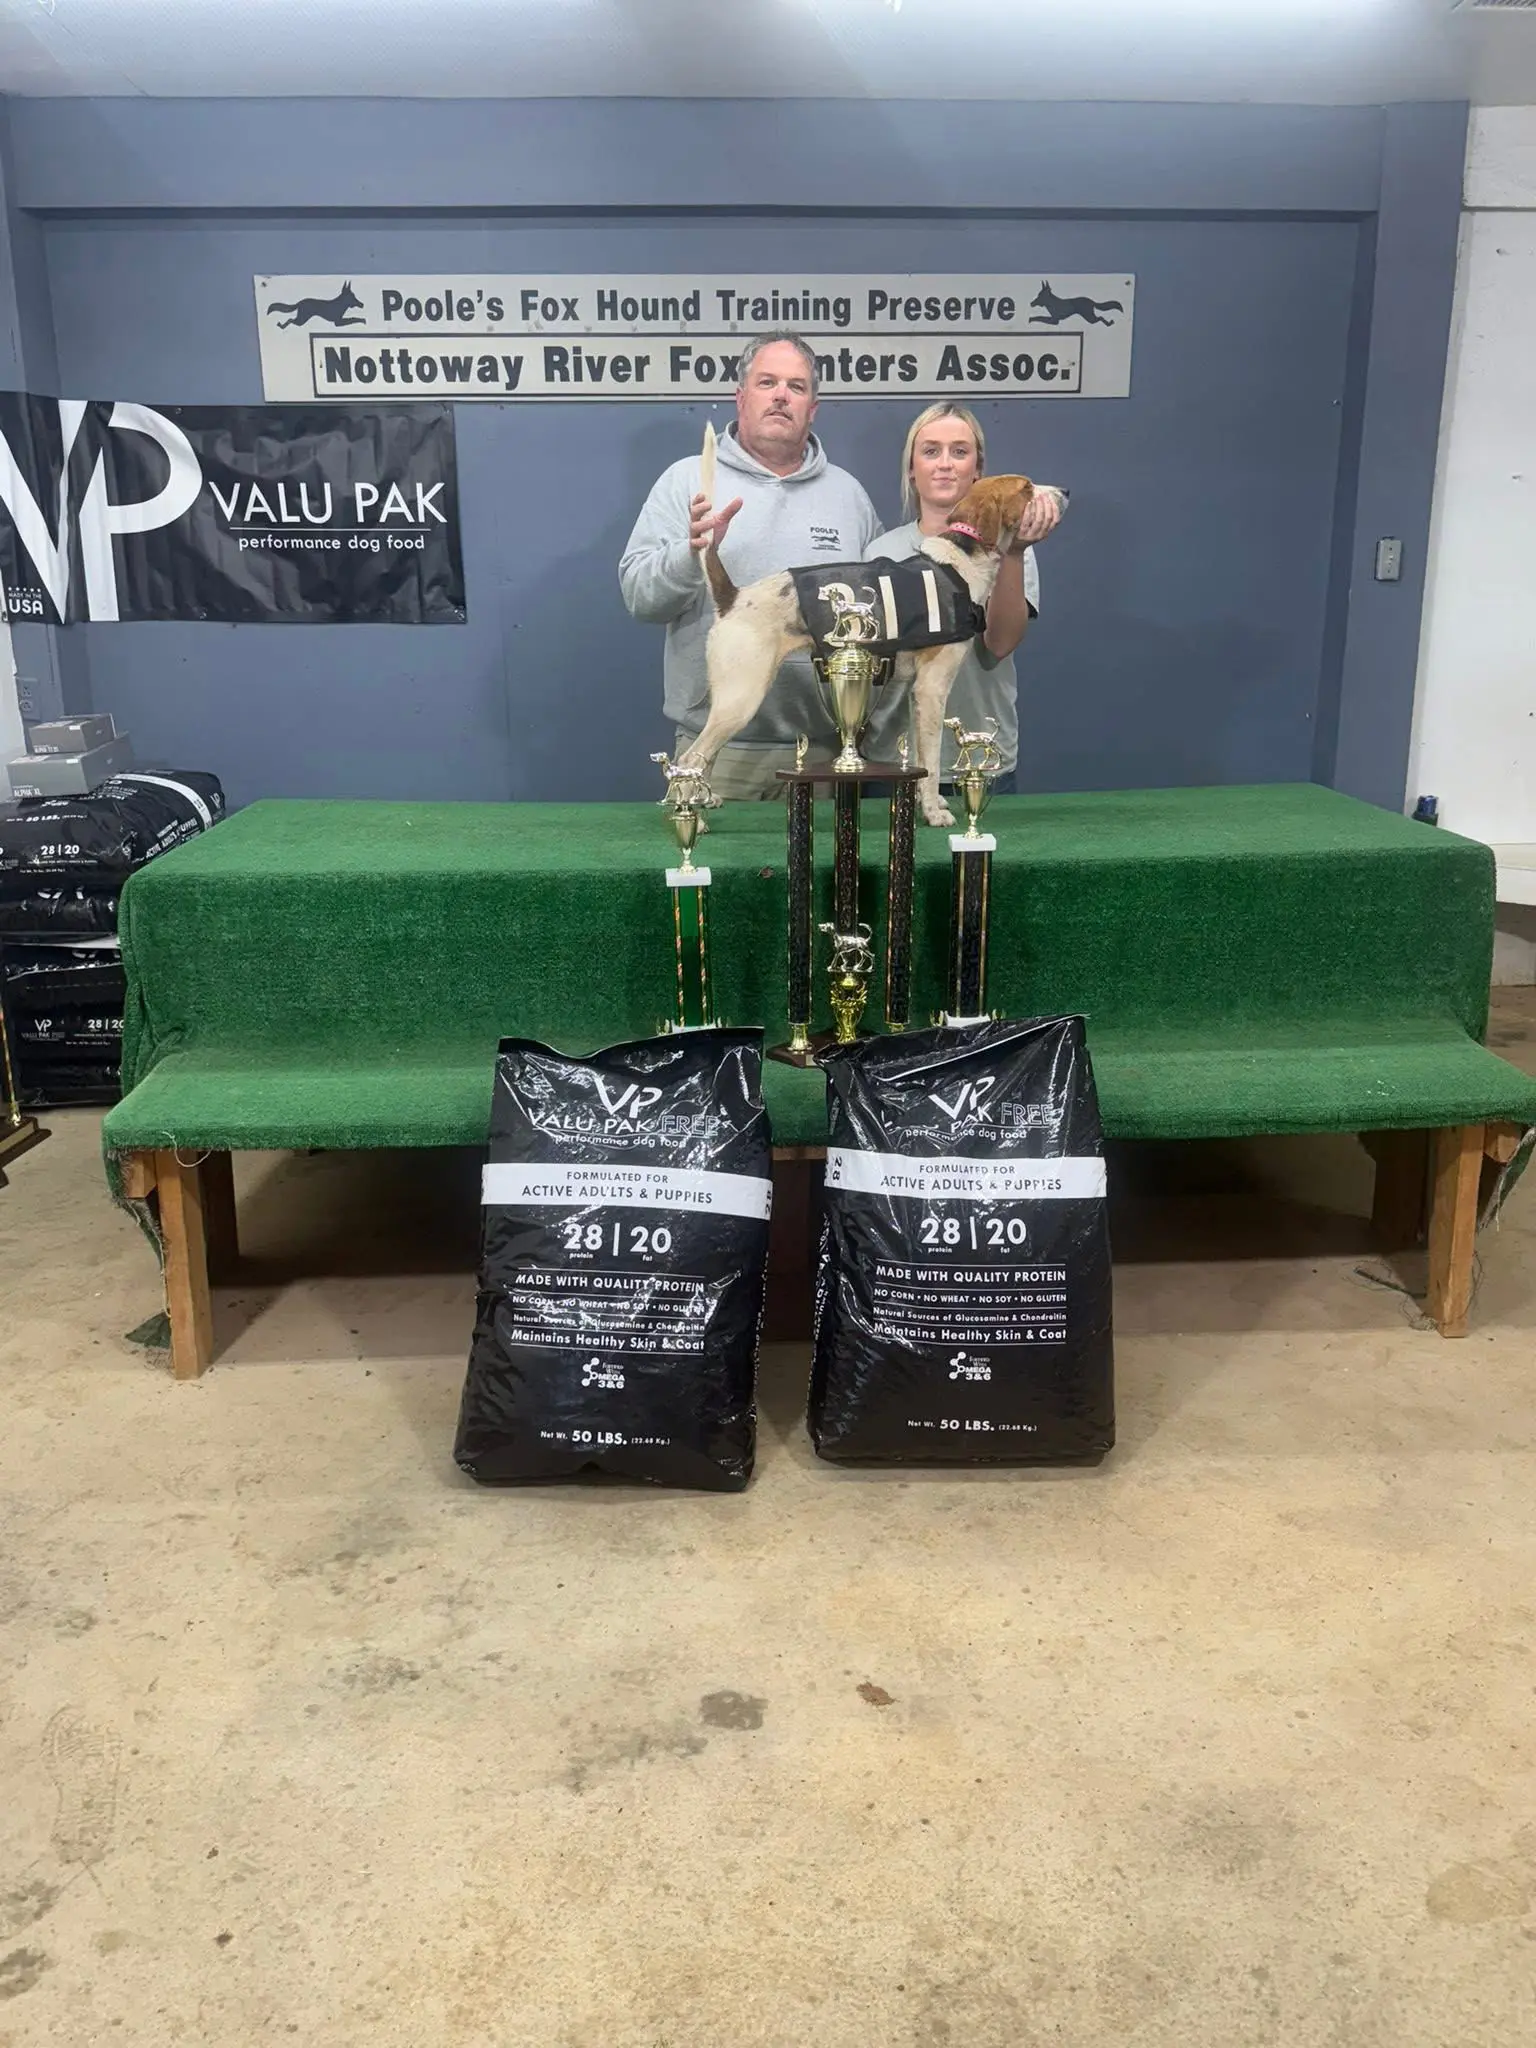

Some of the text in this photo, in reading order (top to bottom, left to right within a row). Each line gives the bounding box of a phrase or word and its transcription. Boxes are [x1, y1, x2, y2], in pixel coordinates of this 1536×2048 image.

[382, 289, 1016, 327] Poole's Fox Hound Training Preserve
[324, 344, 1071, 391] Nottoway River Fox nters Assoc.
[208, 480, 448, 525] VALU PAK
[238, 534, 426, 553] performance dog food
[9, 599, 44, 615] USA
[40, 844, 80, 855] 28 20
[34, 1019, 52, 1032] VP
[88, 1019, 102, 1028] 28
[594, 1077, 663, 1119] VP
[928, 1075, 996, 1121] VP
[527, 1107, 719, 1137] VALU PAK FREE
[1001, 1102, 1053, 1126] FREE
[633, 1135, 656, 1148] dog
[978, 1127, 997, 1141] dog
[1000, 1127, 1027, 1140] food
[566, 1171, 669, 1183] FORMULATED FOR
[919, 1164, 1016, 1174] FORMULATED FOR
[880, 1175, 925, 1190] ACTIVE
[931, 1178, 983, 1191] ADULTS
[1004, 1178, 1062, 1191] PUPPIES
[522, 1185, 713, 1204] ACTIVE ADULTS & PUPPIES
[563, 1223, 672, 1254] 28 20
[920, 1217, 1027, 1245] 28 20
[569, 1252, 594, 1260] protein
[642, 1254, 653, 1262] fat
[928, 1246, 953, 1254] protein
[876, 1265, 1066, 1283] MADE WITH QUALITY PROTEIN
[515, 1274, 704, 1292] MADE WITH QUALITY PROTEIN
[512, 1295, 526, 1304] NO
[633, 1302, 650, 1311] SOY
[658, 1304, 671, 1312] NO
[874, 1288, 1067, 1304] NO CORN NO WHEAT NO SOY NO GLUTEN
[513, 1313, 542, 1323] Natural
[873, 1306, 905, 1318] Natural
[907, 1311, 940, 1321] Sources
[943, 1312, 952, 1321] of
[955, 1313, 1009, 1322] Glucosamine
[1020, 1312, 1067, 1321] Chondroitin
[511, 1329, 705, 1350] Maintains Healthy Skin & Coat
[873, 1322, 1067, 1343] Maintains Healthy Skin & Coat
[957, 1365, 992, 1374] OMEGA
[939, 1419, 960, 1430] 50
[965, 1420, 995, 1431] LBS.
[540, 1430, 554, 1439] Net
[556, 1431, 568, 1440] Wt.
[572, 1430, 593, 1443] 50
[597, 1431, 628, 1445] LBS.
